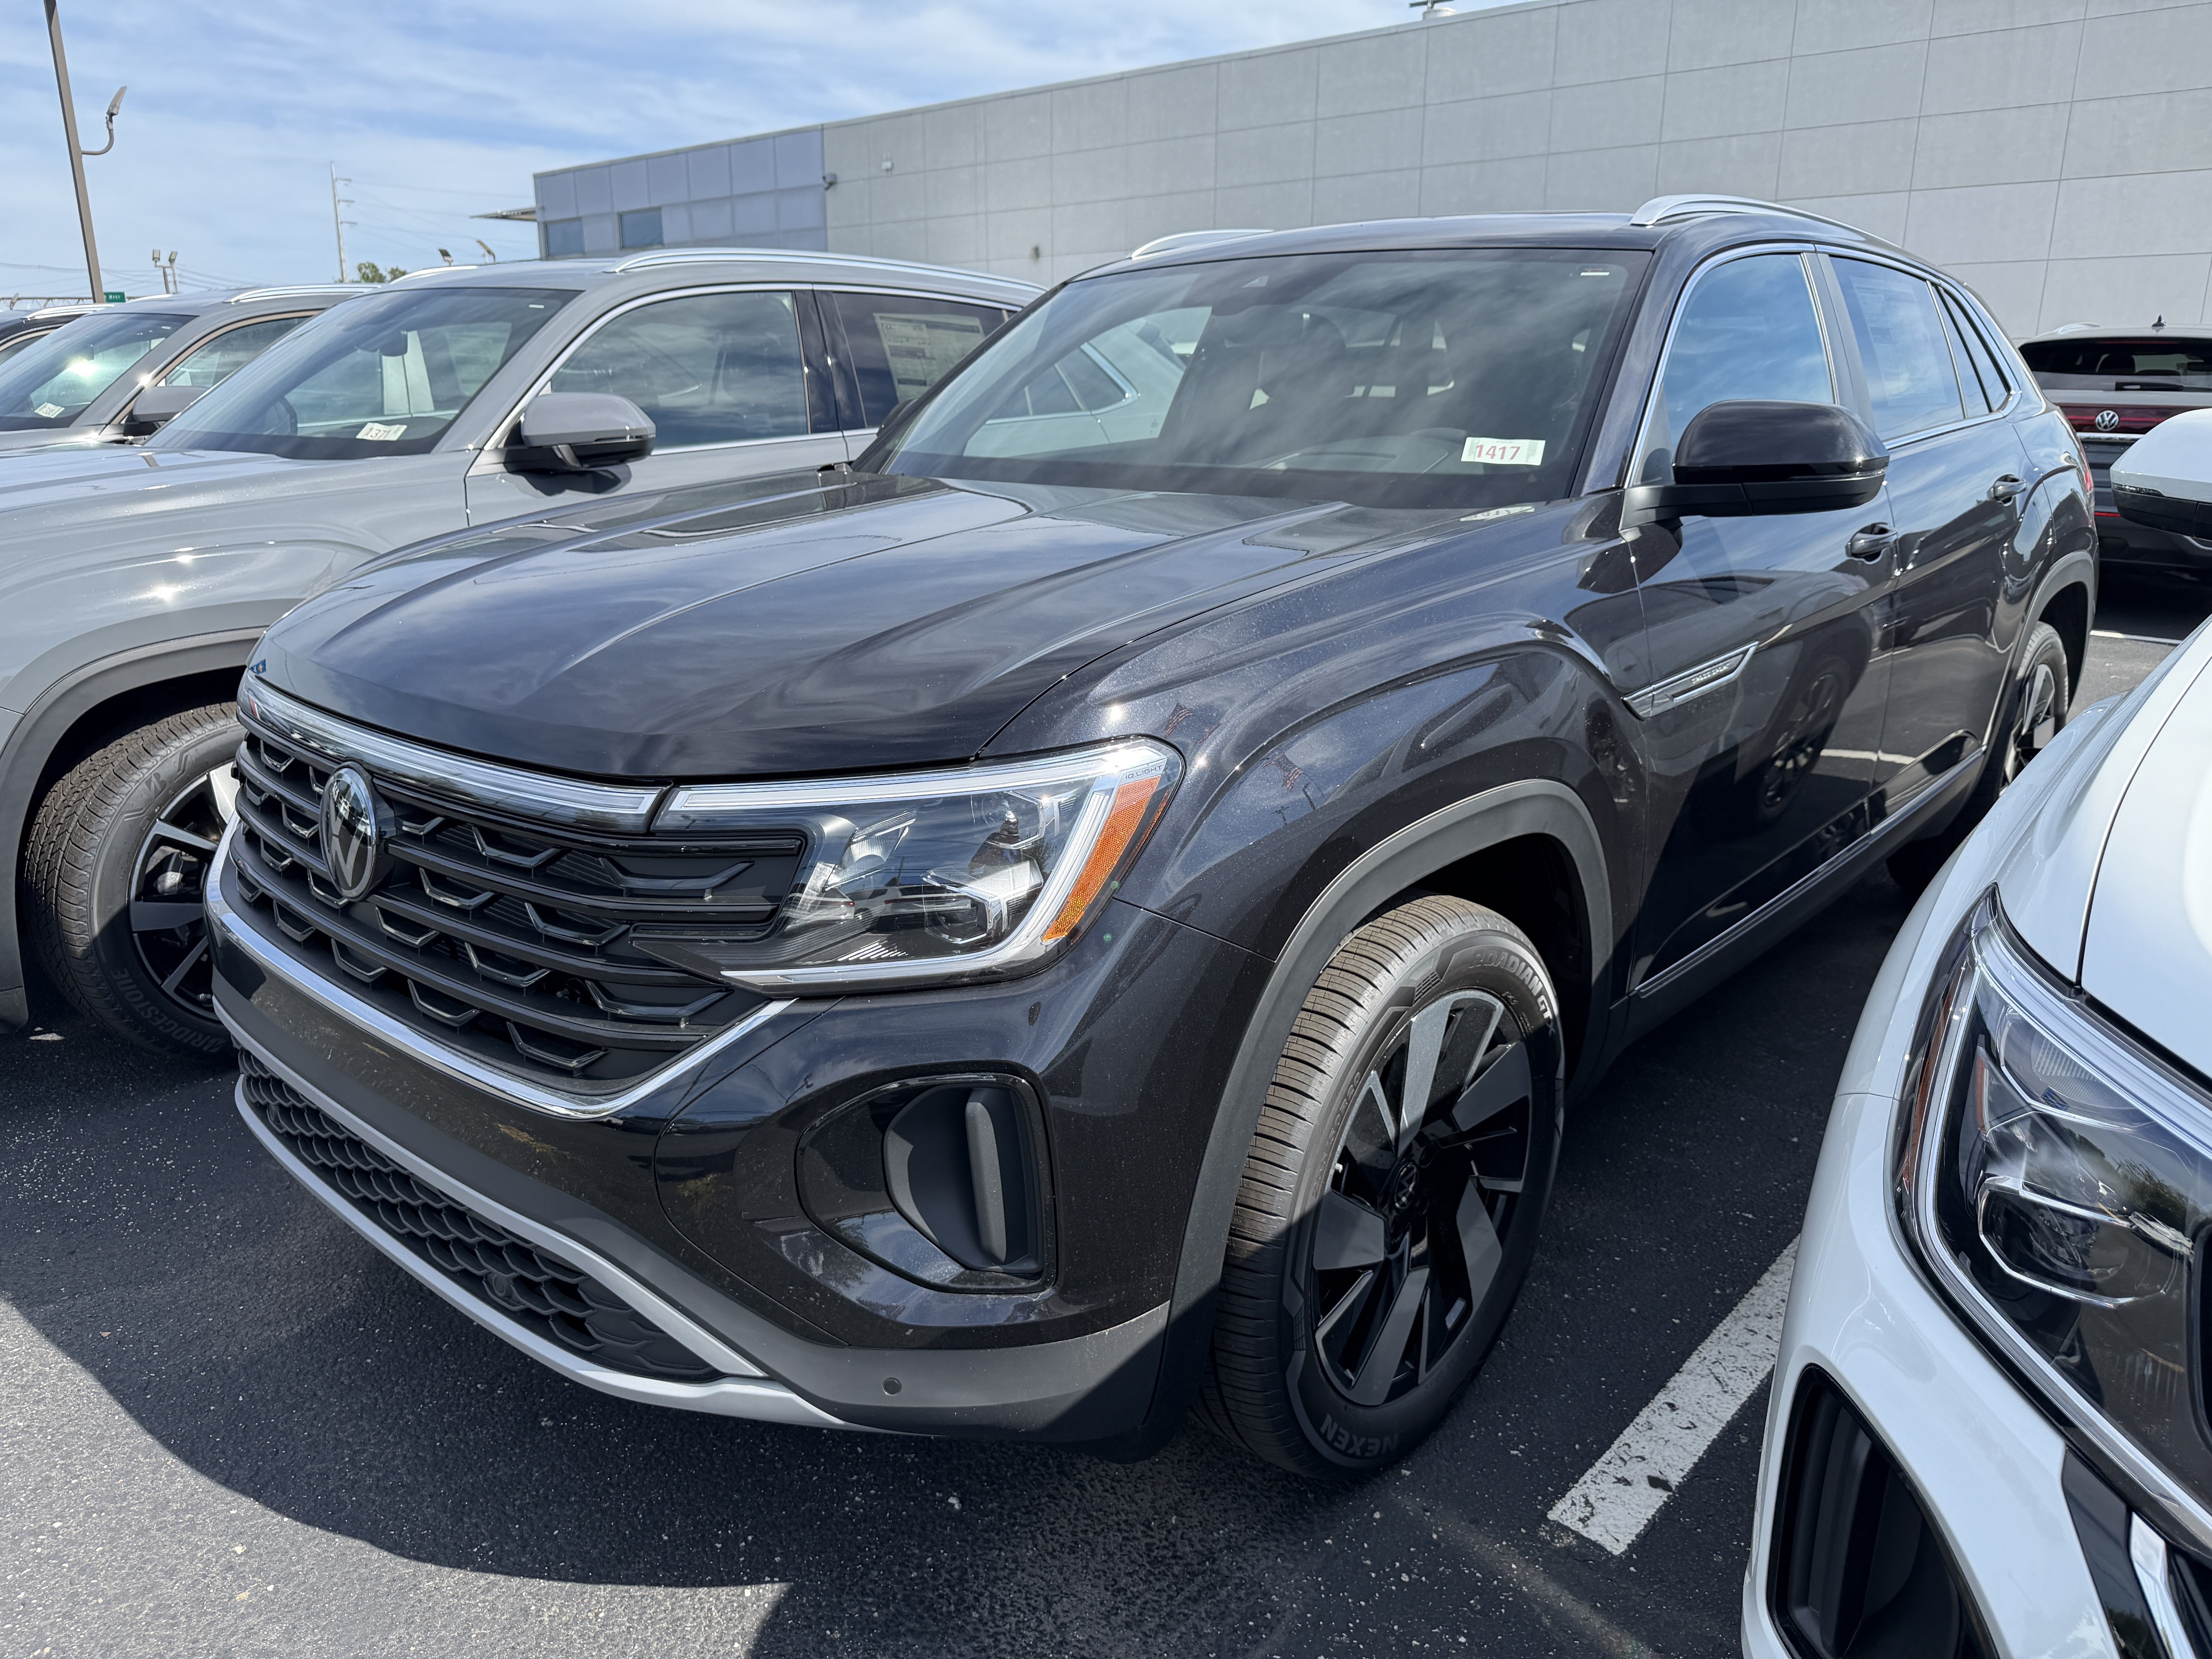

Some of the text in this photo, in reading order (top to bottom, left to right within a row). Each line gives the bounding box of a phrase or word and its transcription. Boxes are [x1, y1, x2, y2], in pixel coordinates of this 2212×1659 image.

[1476, 444, 1520, 460] 1417
[1125, 765, 1163, 780] IQ.LIGHT
[110, 967, 227, 1053] BRIDGESTONE
[1319, 1413, 1399, 1456] NEXEN
